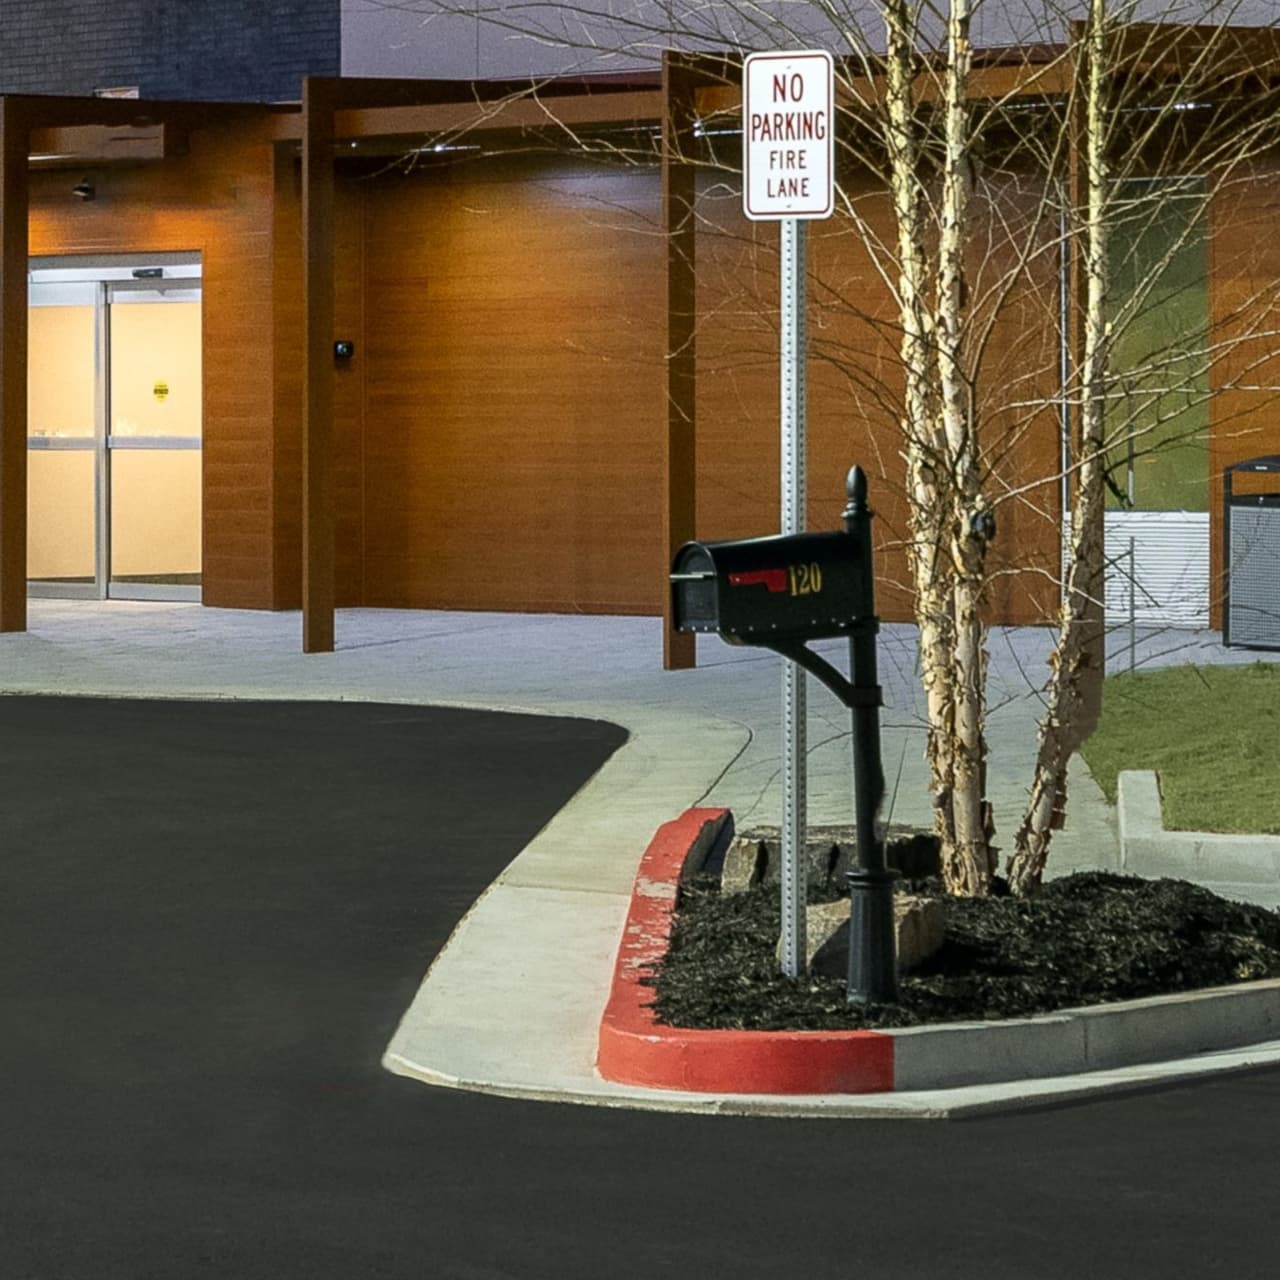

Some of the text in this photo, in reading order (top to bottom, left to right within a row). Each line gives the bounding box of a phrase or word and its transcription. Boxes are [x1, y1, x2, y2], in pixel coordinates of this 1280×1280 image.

[773, 73, 804, 103] NO
[751, 111, 826, 142] PARKING
[769, 150, 807, 170] FIRE
[767, 177, 810, 198] LANE
[787, 562, 822, 596] 120
